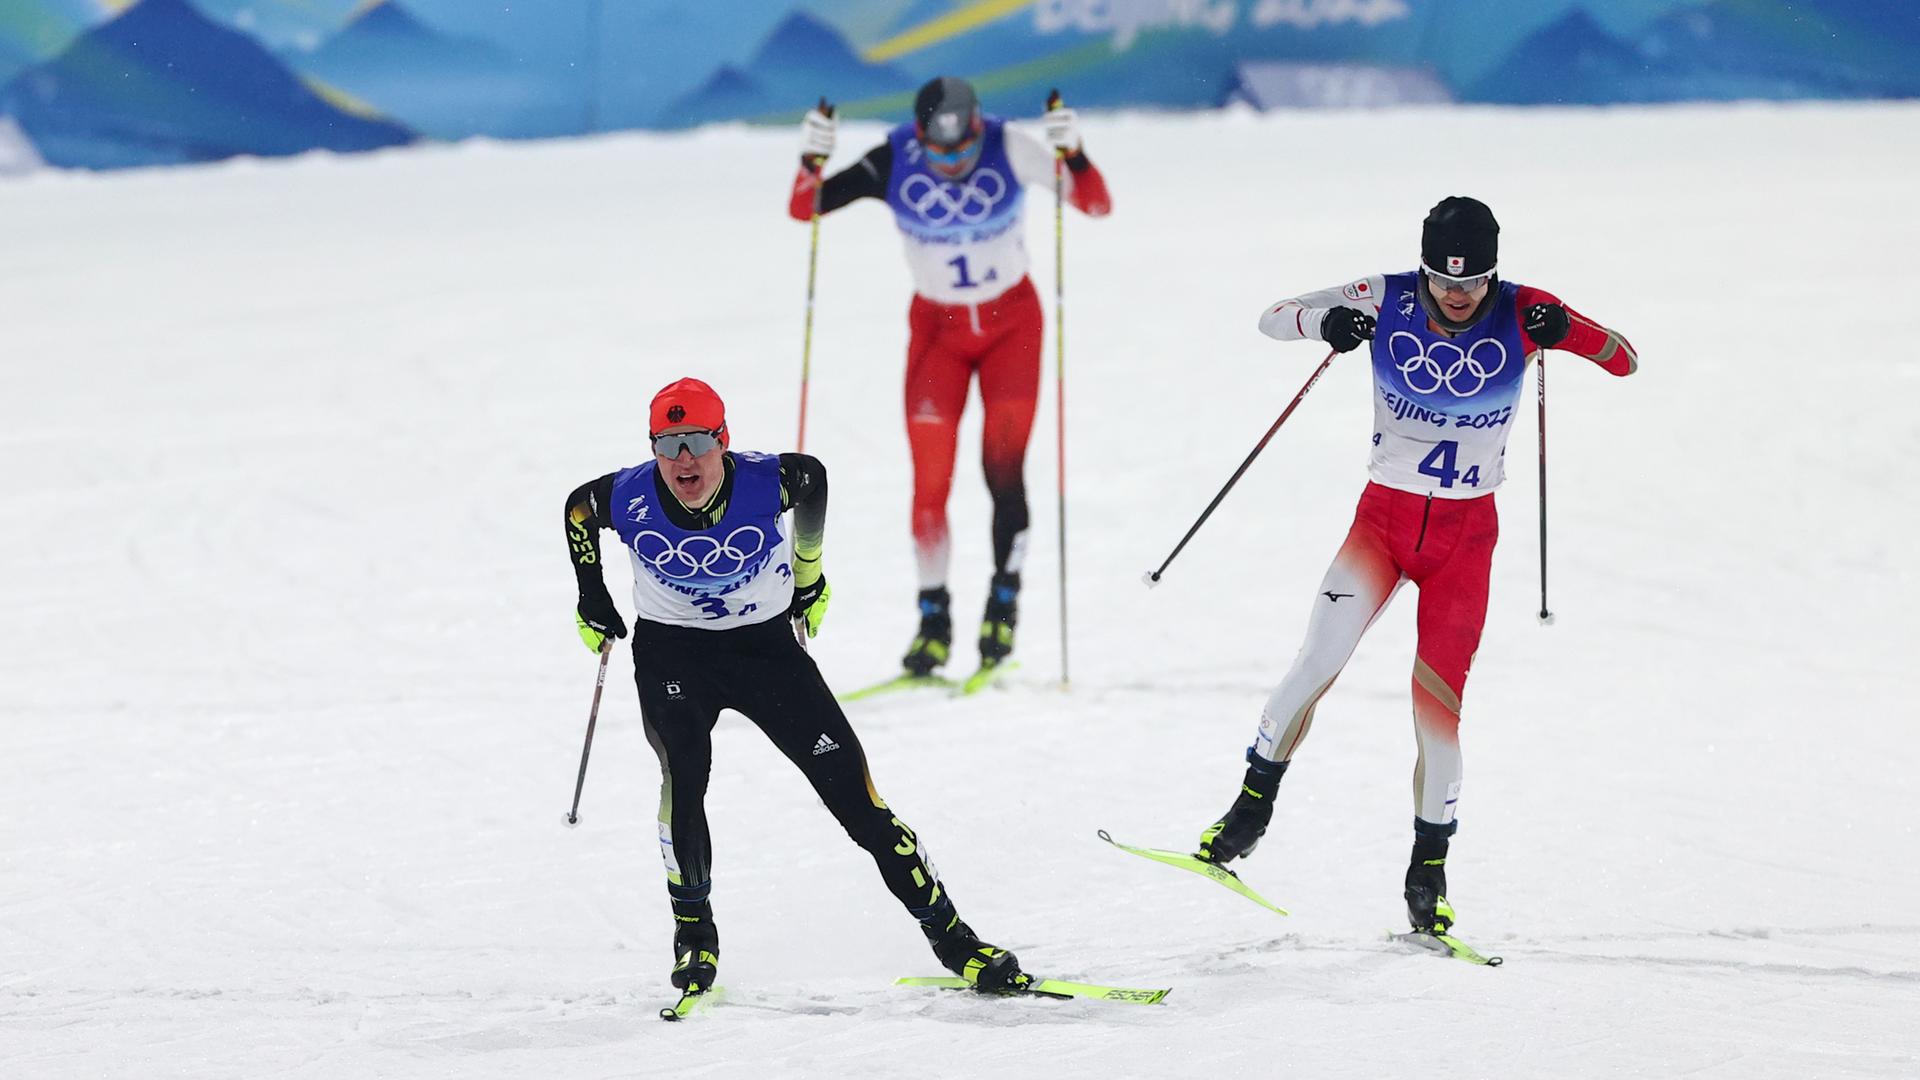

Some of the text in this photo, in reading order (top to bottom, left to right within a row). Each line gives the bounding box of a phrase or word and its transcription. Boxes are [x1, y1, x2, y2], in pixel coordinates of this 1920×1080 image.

[948, 255, 977, 288] 1
[1455, 406, 1513, 429] 2022
[1418, 440, 1480, 488] 4 4
[690, 597, 730, 620] 3
[812, 742, 840, 756] adidas
